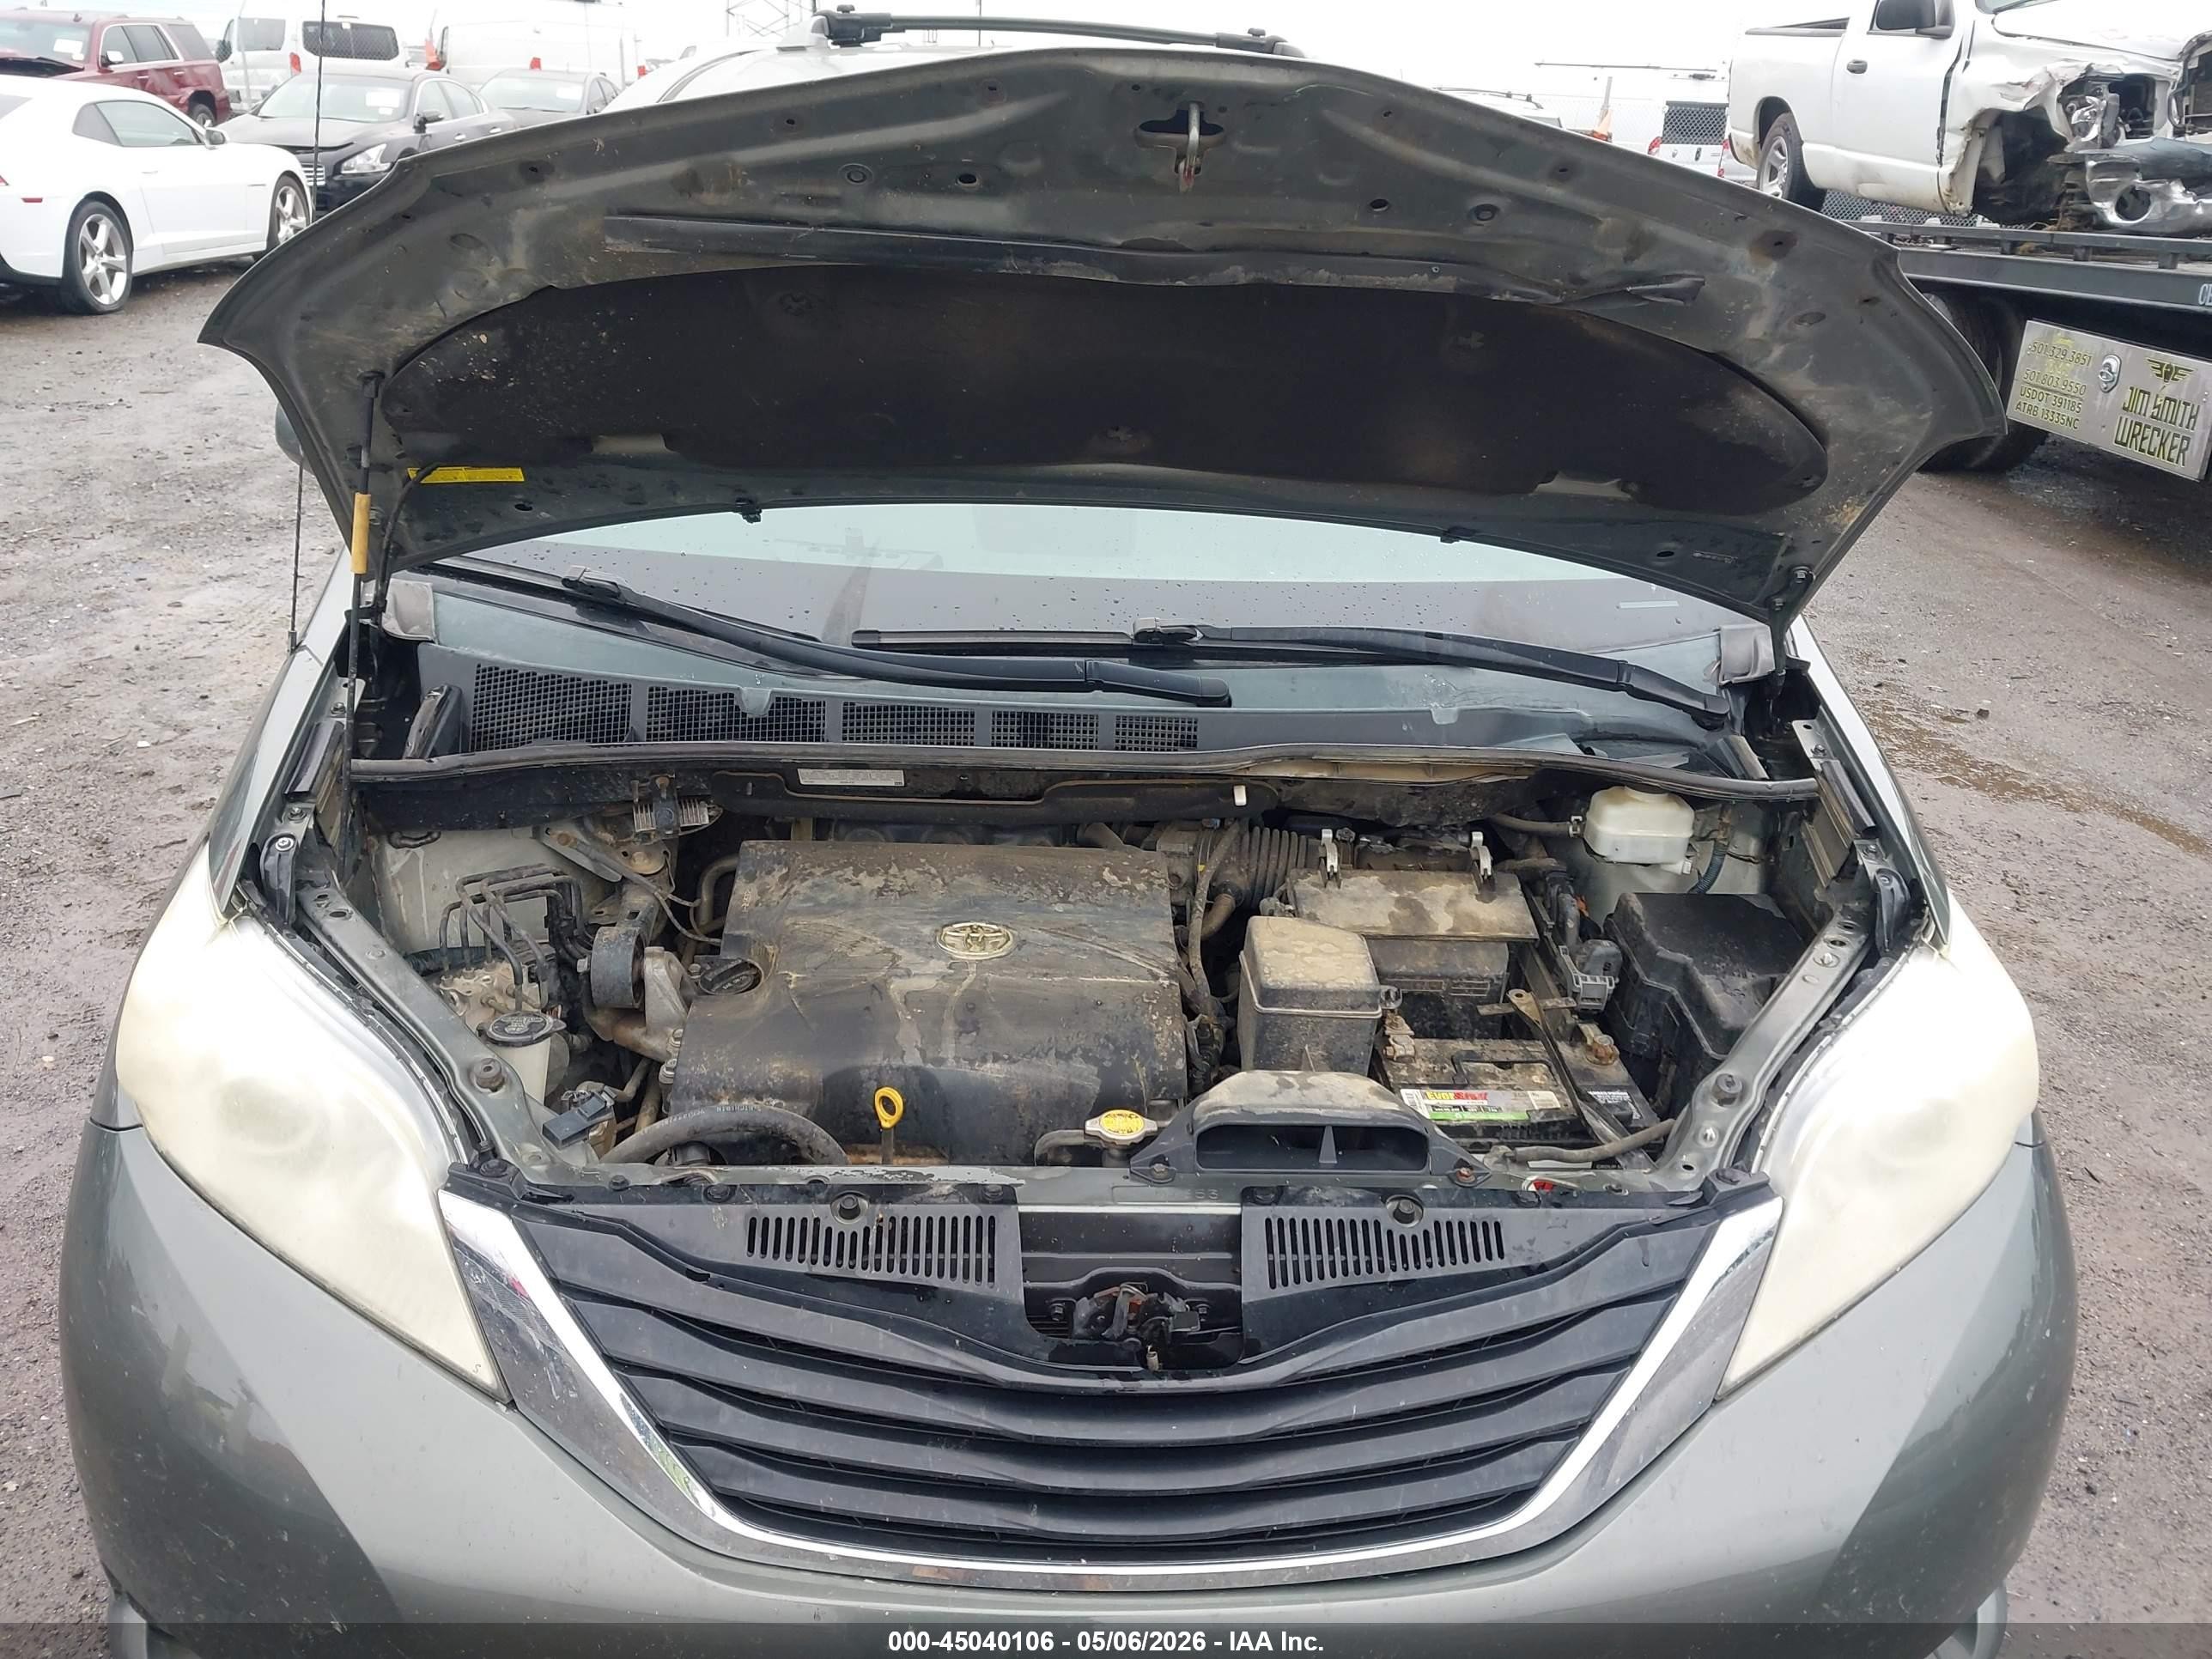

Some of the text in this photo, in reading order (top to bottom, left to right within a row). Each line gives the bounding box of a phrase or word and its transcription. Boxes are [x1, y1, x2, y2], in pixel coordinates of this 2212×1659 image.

[2032, 342, 2092, 366] 501.329.3851
[2020, 386, 2082, 413] USDOT 391185
[2123, 386, 2200, 430] JIM SMITH
[2015, 401, 2080, 429] ATRB 13335NC
[2115, 416, 2191, 466] WRECKER
